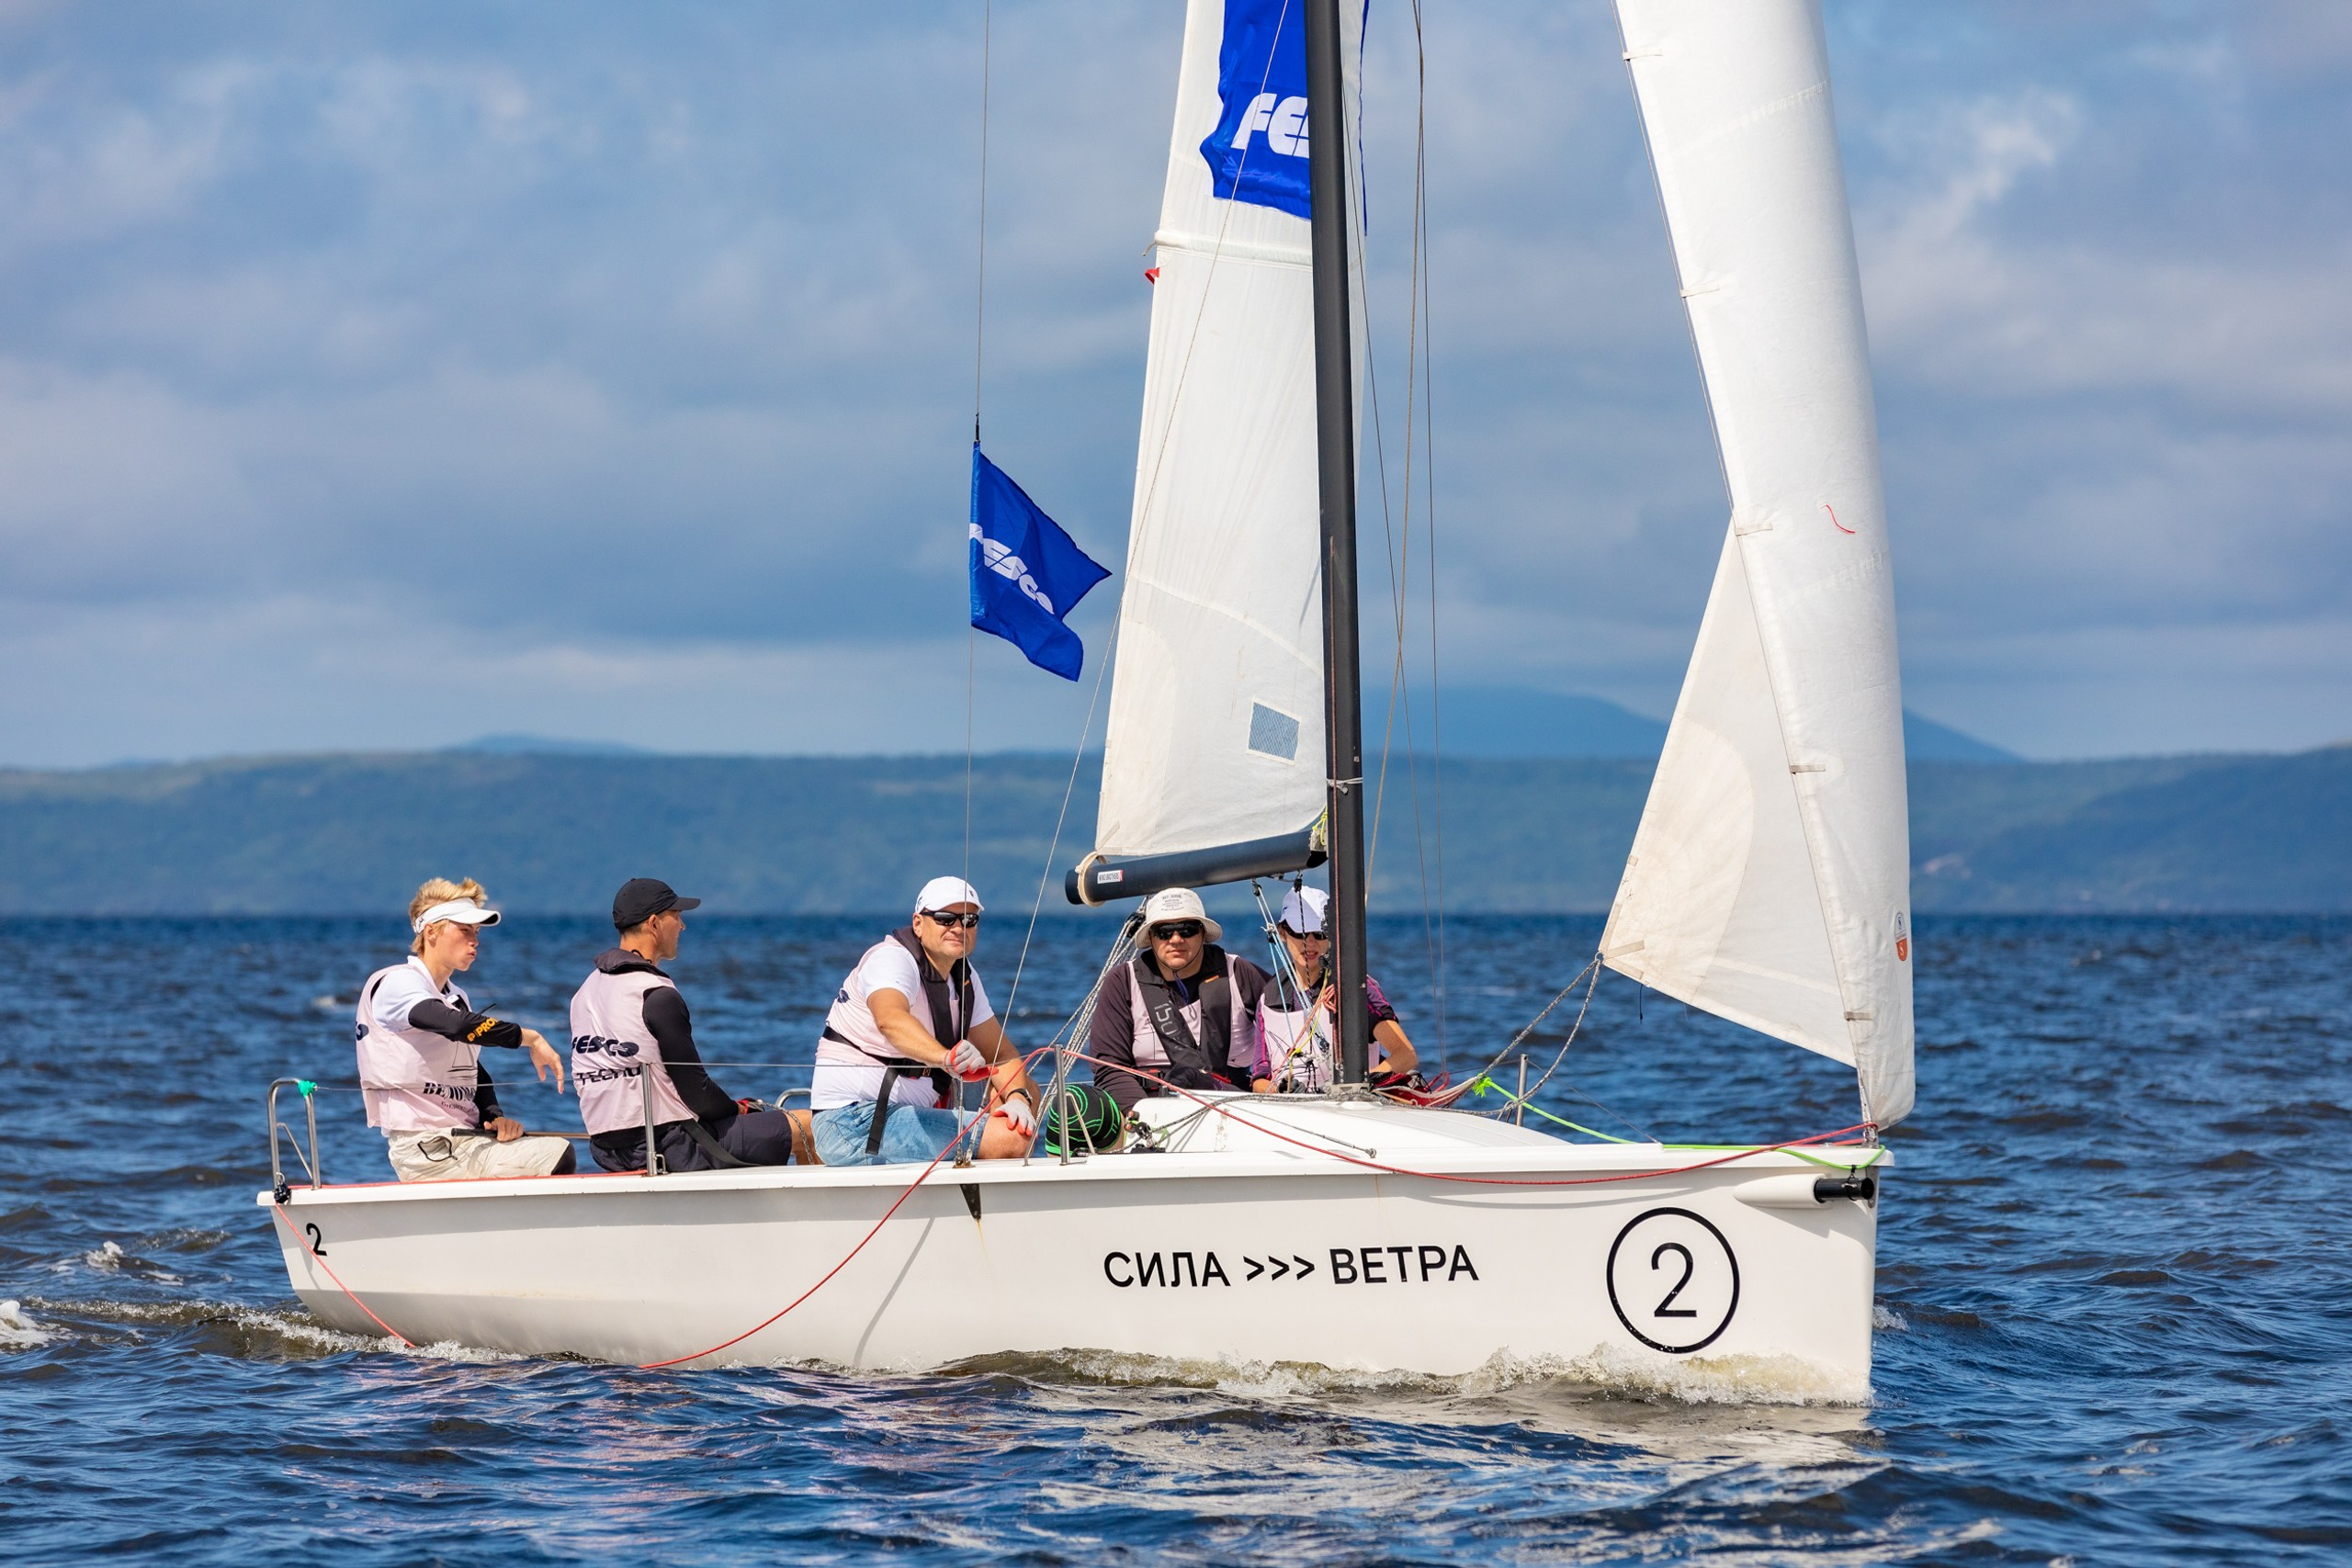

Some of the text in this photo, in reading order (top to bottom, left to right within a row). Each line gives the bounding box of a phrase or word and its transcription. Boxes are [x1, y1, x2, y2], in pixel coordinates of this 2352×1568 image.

[305, 1223, 328, 1257] 2
[1103, 1251, 1231, 1288] СИЛА
[1329, 1245, 1480, 1285] ВЕТРА
[1651, 1242, 1697, 1318] 2
